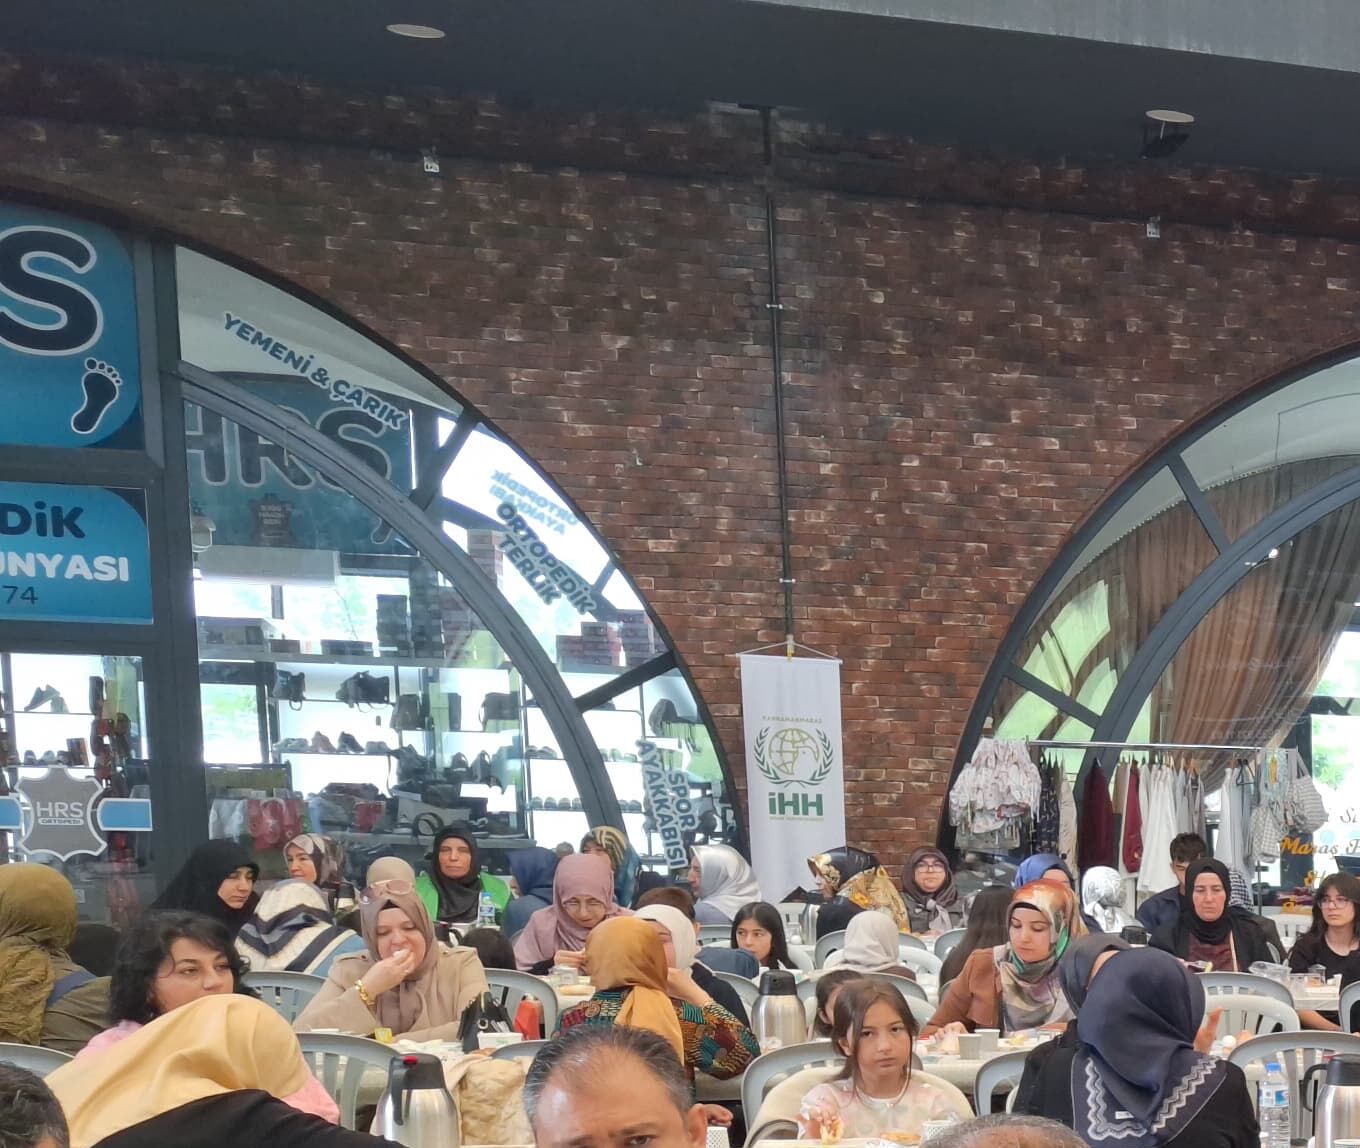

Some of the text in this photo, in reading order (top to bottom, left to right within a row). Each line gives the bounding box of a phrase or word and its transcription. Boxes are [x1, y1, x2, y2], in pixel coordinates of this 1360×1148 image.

[333, 379, 405, 428] ÇARIK
[0, 551, 129, 582] NYASI
[2, 585, 38, 604] 74
[37, 802, 83, 818] HRS
[668, 772, 697, 831] SPOR
